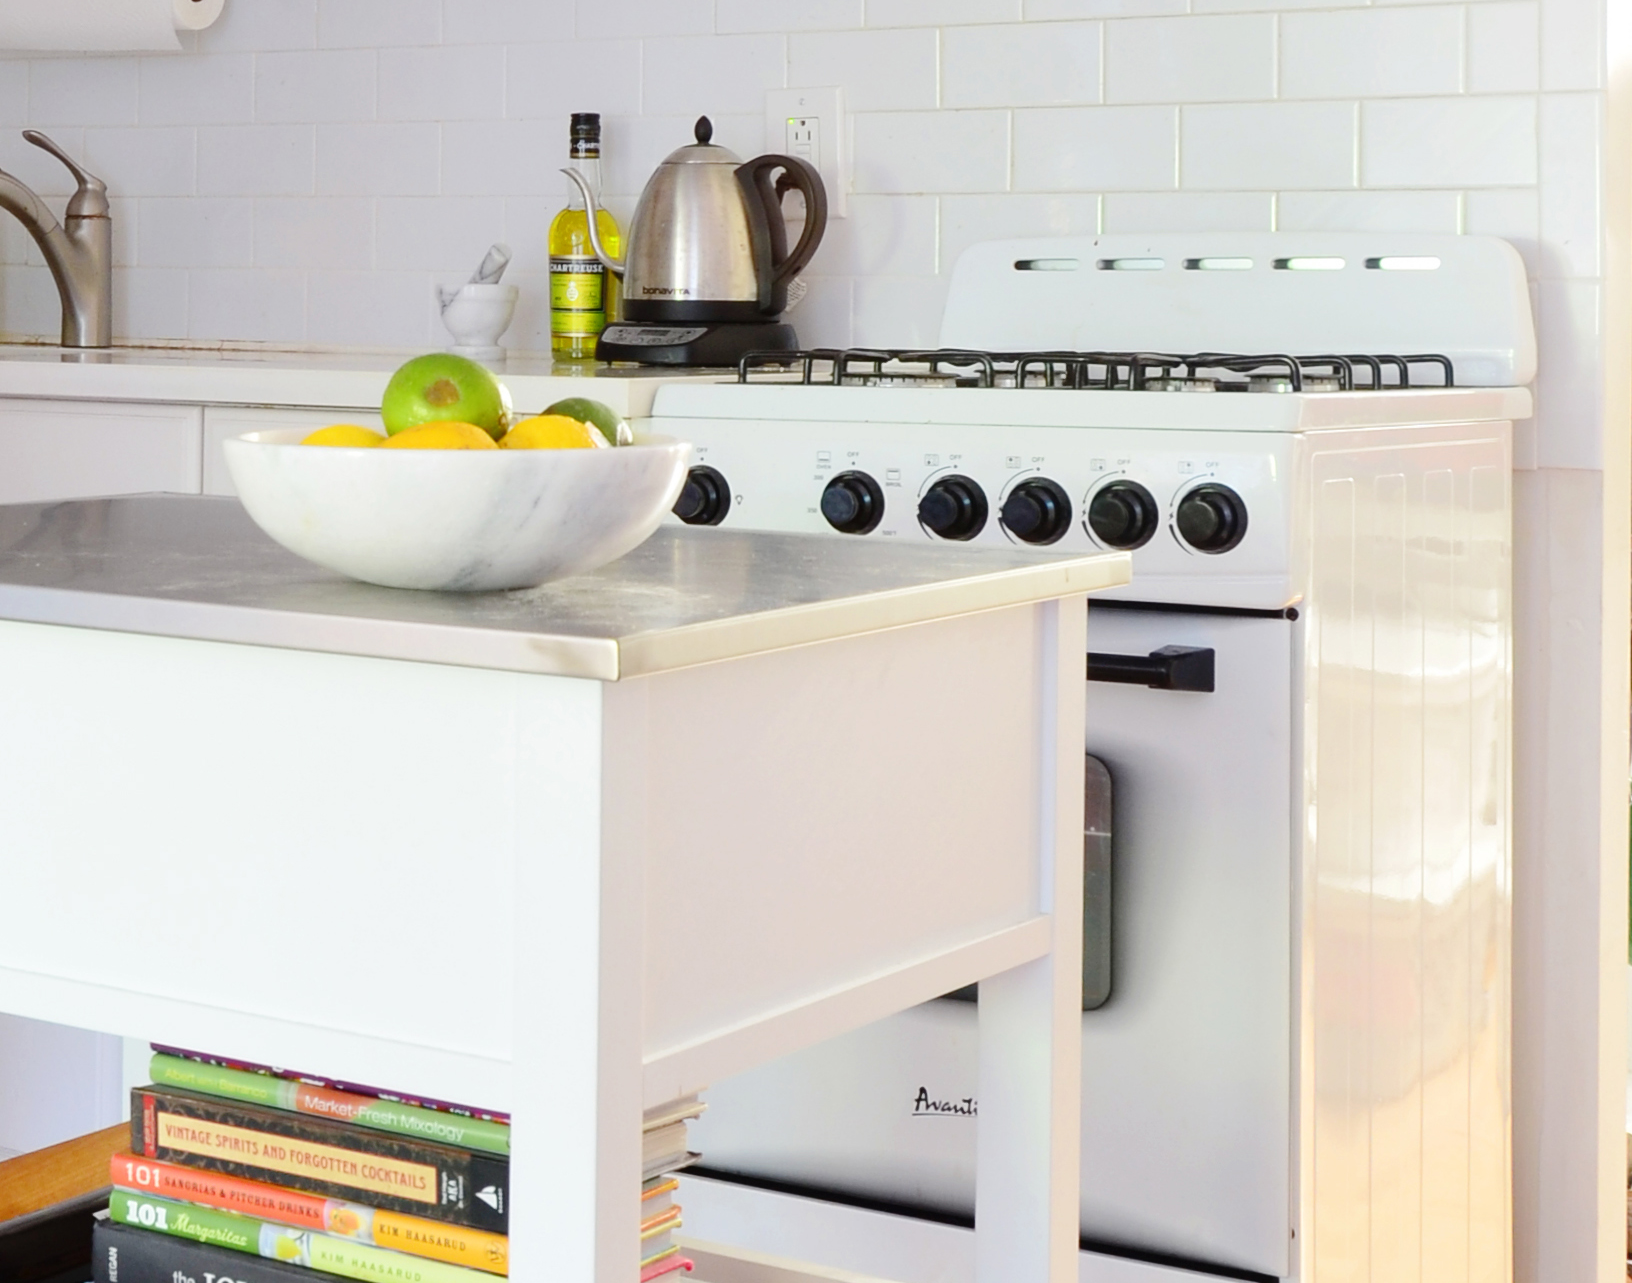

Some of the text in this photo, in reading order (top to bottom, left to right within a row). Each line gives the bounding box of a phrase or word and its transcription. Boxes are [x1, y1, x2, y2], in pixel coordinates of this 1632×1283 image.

[304, 1095, 465, 1143] Market-Fresh Mixology
[914, 1086, 978, 1116] Avanti
[165, 1124, 212, 1147] VINTAGE
[215, 1134, 260, 1155] SPIRITS
[262, 1143, 287, 1161] AND
[290, 1150, 358, 1176] FORGOTTEN
[361, 1163, 427, 1190] COCKTAILS
[125, 1162, 320, 1219] 101 SANGRIAS & PITCHER DRINKS
[126, 1200, 248, 1247] 101 Margaritas
[378, 1223, 466, 1252] KIM HAASARUD
[108, 1246, 118, 1283] REGAN
[321, 1250, 422, 1283] KIM HAASARUD
